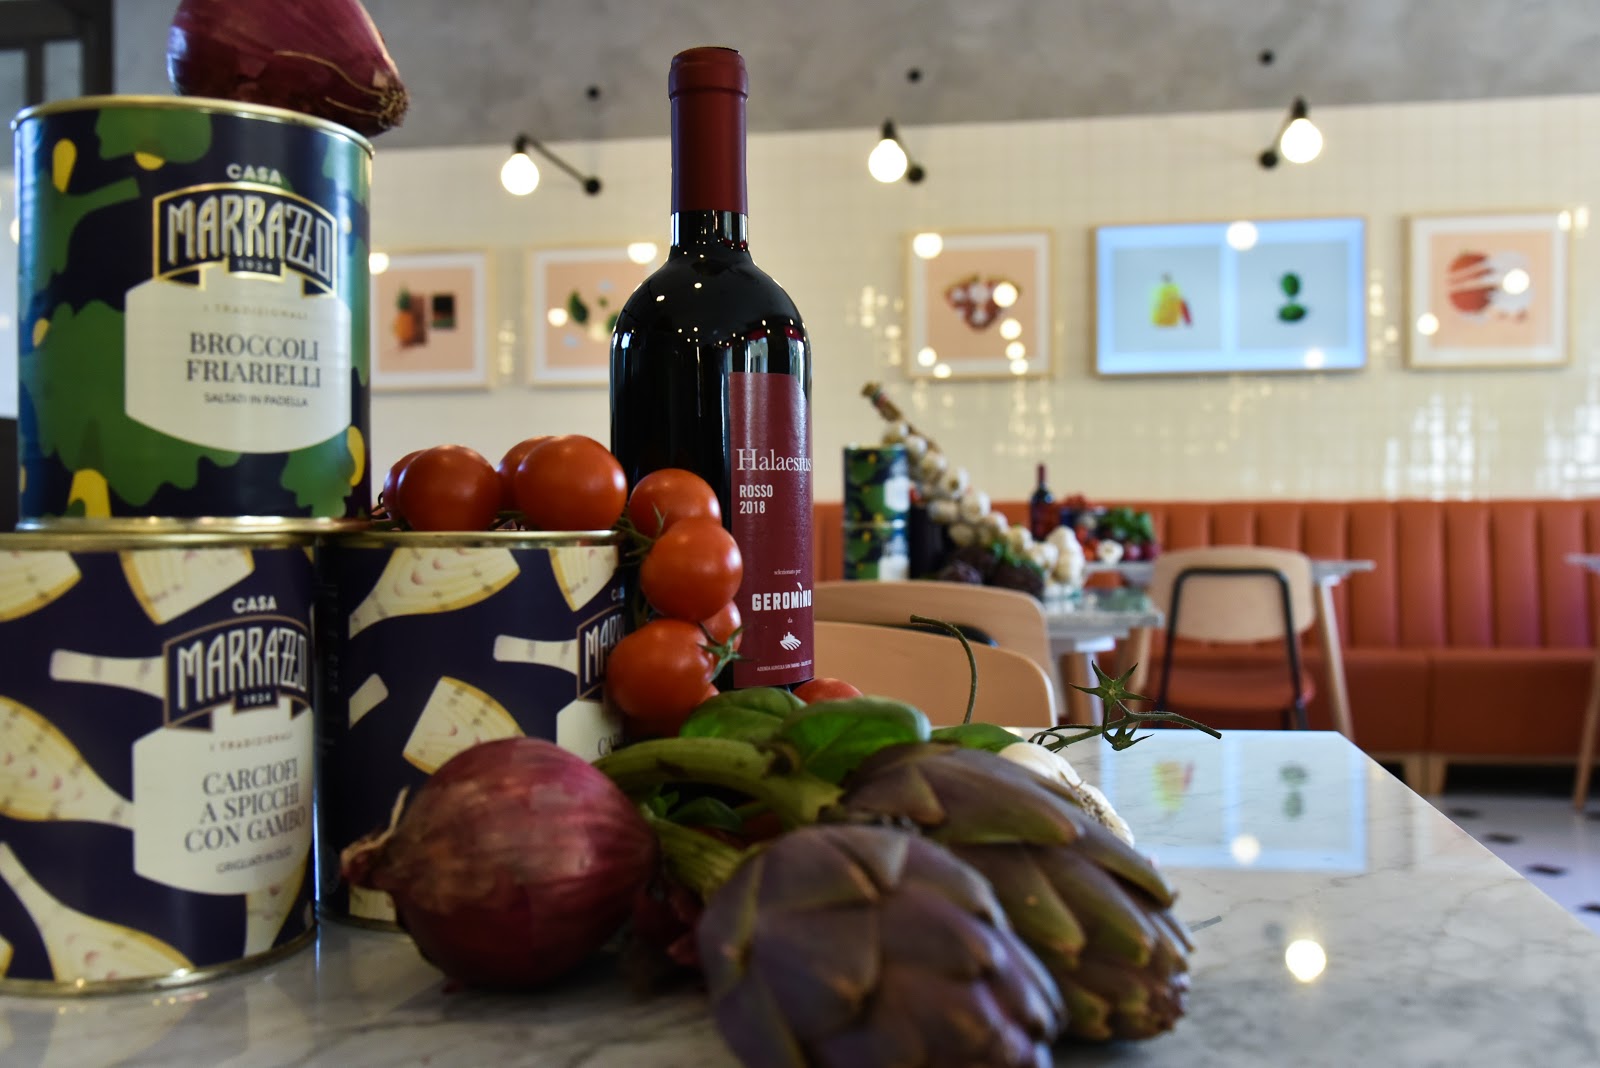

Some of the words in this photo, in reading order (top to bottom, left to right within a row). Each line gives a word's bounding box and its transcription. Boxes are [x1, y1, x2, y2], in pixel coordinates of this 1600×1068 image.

[226, 163, 282, 184] CASA
[167, 195, 332, 281] MARRAZZO
[189, 332, 319, 362] BROCCOLI
[186, 358, 321, 388] FRIARIELLI
[739, 484, 773, 498] ROSSO
[739, 500, 766, 514] 2018
[232, 596, 277, 614] CASA
[177, 627, 308, 711] MARRAZZO
[202, 758, 298, 796] CARCIOFI
[200, 802, 217, 824] A
[223, 783, 299, 821] SPICCHI
[184, 822, 241, 853] CON
